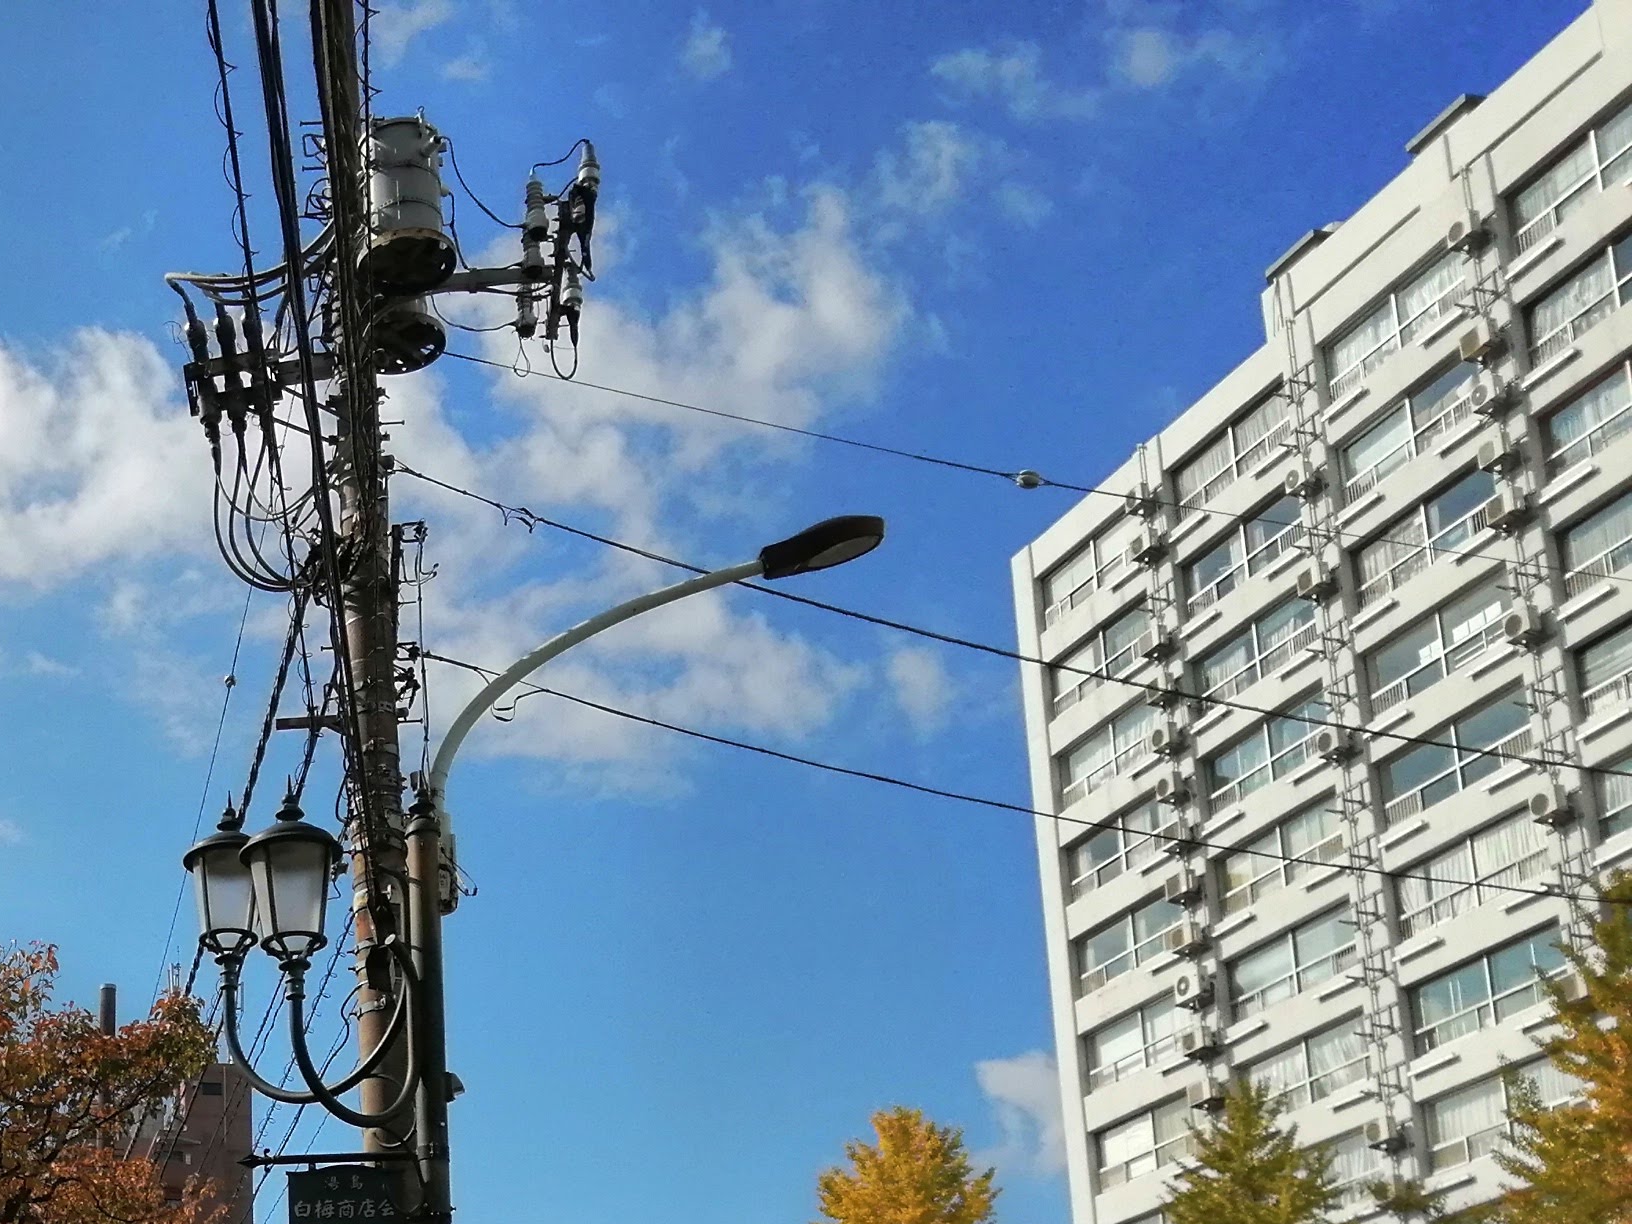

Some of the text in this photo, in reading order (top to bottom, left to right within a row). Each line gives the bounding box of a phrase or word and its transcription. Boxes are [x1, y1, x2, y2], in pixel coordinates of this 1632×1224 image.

[294, 1199, 395, 1219] 白梅商店会
